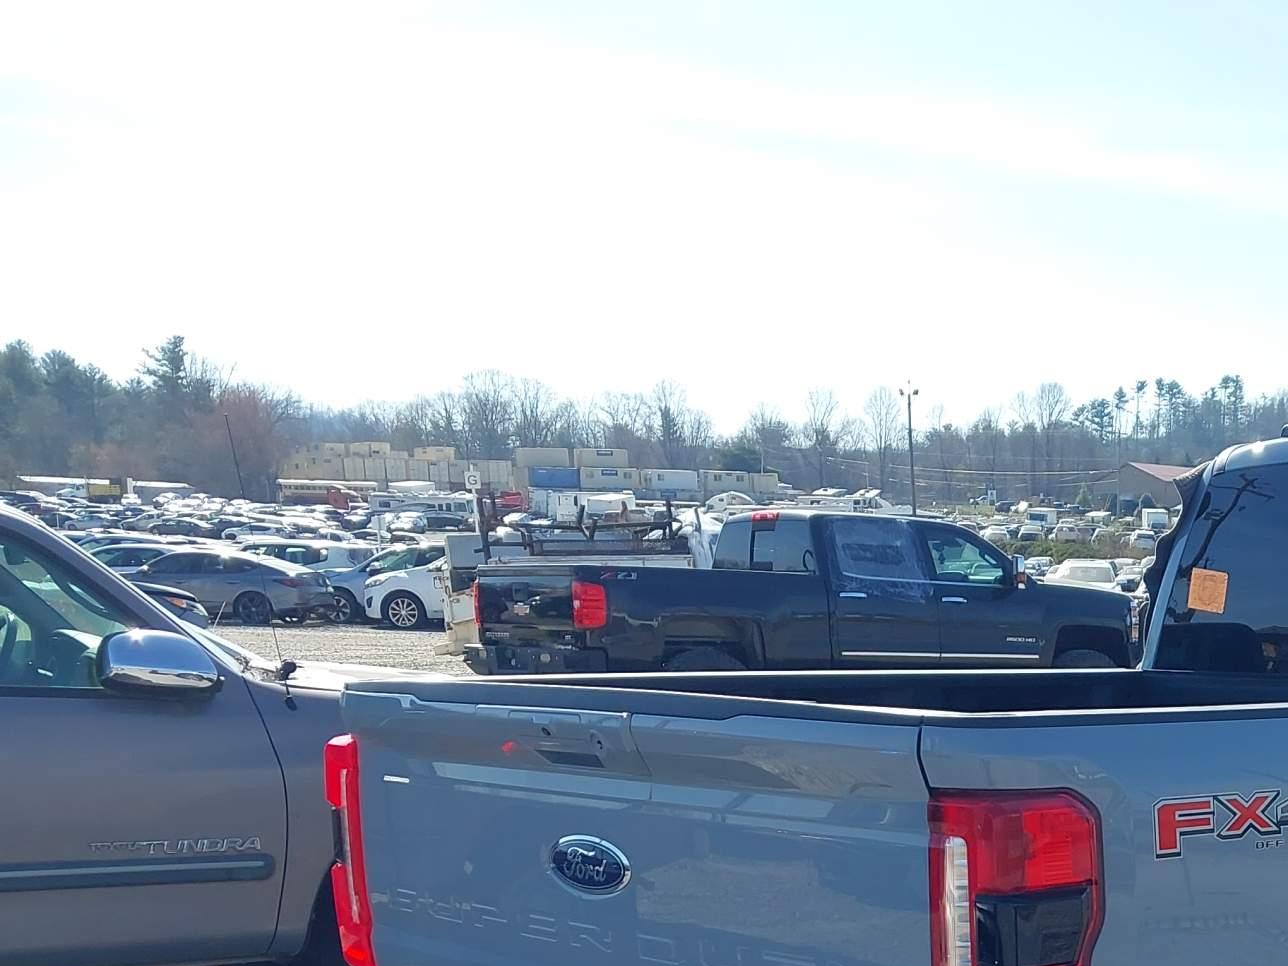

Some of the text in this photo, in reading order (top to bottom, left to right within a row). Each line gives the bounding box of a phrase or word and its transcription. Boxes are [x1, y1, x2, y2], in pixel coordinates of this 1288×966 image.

[467, 473, 478, 486] G
[145, 836, 262, 854] TUNDRA
[1254, 839, 1286, 850] OFF
[562, 845, 608, 882] Ford
